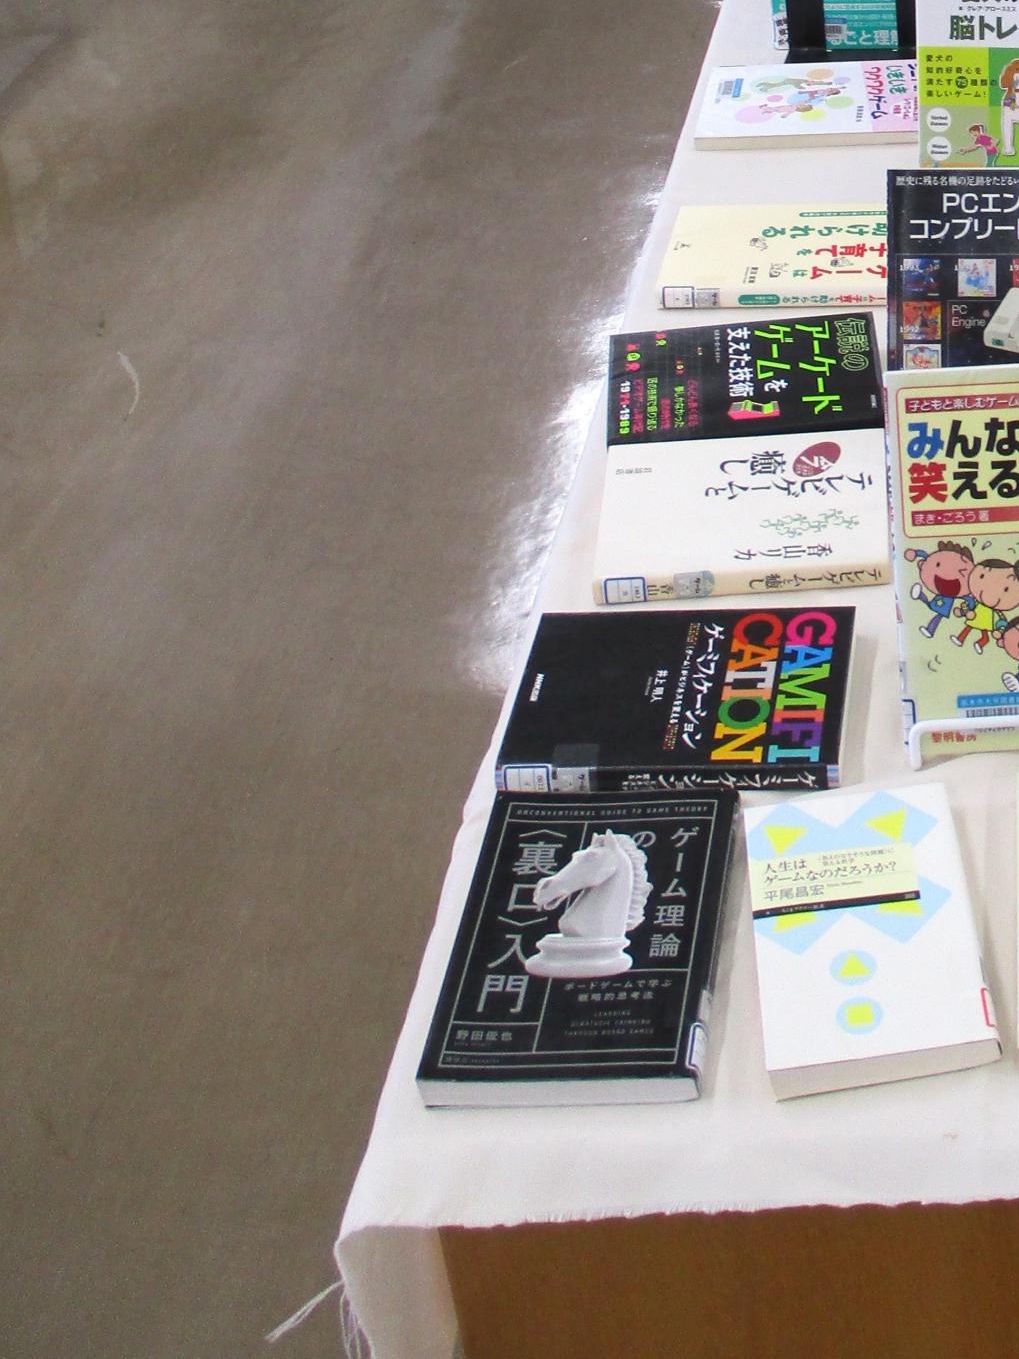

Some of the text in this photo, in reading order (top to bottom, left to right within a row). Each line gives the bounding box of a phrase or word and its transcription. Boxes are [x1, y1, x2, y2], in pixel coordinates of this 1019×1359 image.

[926, 54, 953, 62] 愛犬の
[951, 305, 968, 314] PC
[951, 316, 985, 329] Engine
[834, 317, 869, 371] 伝説の
[727, 326, 753, 398] 支えた技術
[754, 324, 794, 393] ゲームを
[795, 321, 843, 414] アーケード
[720, 450, 786, 475] 癒し
[705, 472, 873, 500] テレビゲームと
[734, 543, 833, 561] 香山リカ
[683, 622, 726, 749] ゲーミフィケーション
[710, 613, 784, 763] CATION
[767, 612, 837, 763] GAMIFI
[633, 831, 656, 848] の
[765, 860, 807, 874] 人生は
[765, 861, 897, 885] ゲームなのだろうか？
[650, 826, 700, 959] ゲーム理論
[765, 884, 825, 901] 平尾昌宏
[564, 979, 673, 990] ボードゲームで学ぶ
